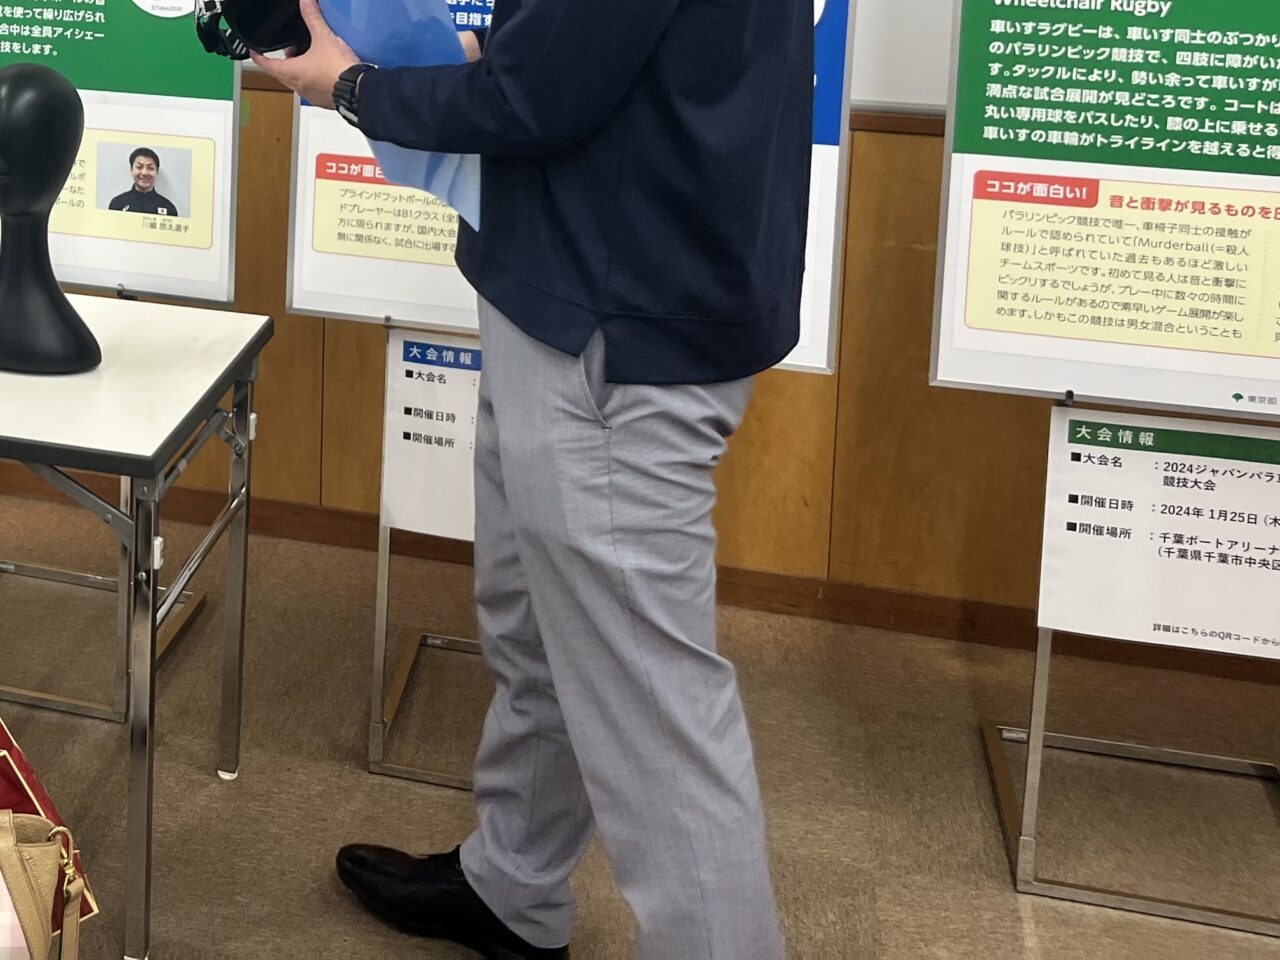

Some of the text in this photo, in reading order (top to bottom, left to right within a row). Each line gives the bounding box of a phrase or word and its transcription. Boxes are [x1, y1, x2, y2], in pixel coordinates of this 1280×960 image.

[987, 62, 1280, 92] す。タックルにより、勢い余って車いすが
[984, 105, 1280, 137] 丸い専用球をパスしたり、膝の上に乗せる
[409, 345, 472, 365] 大会情報
[1076, 425, 1155, 446] 大会情報
[1162, 475, 1217, 492] 競技大会
